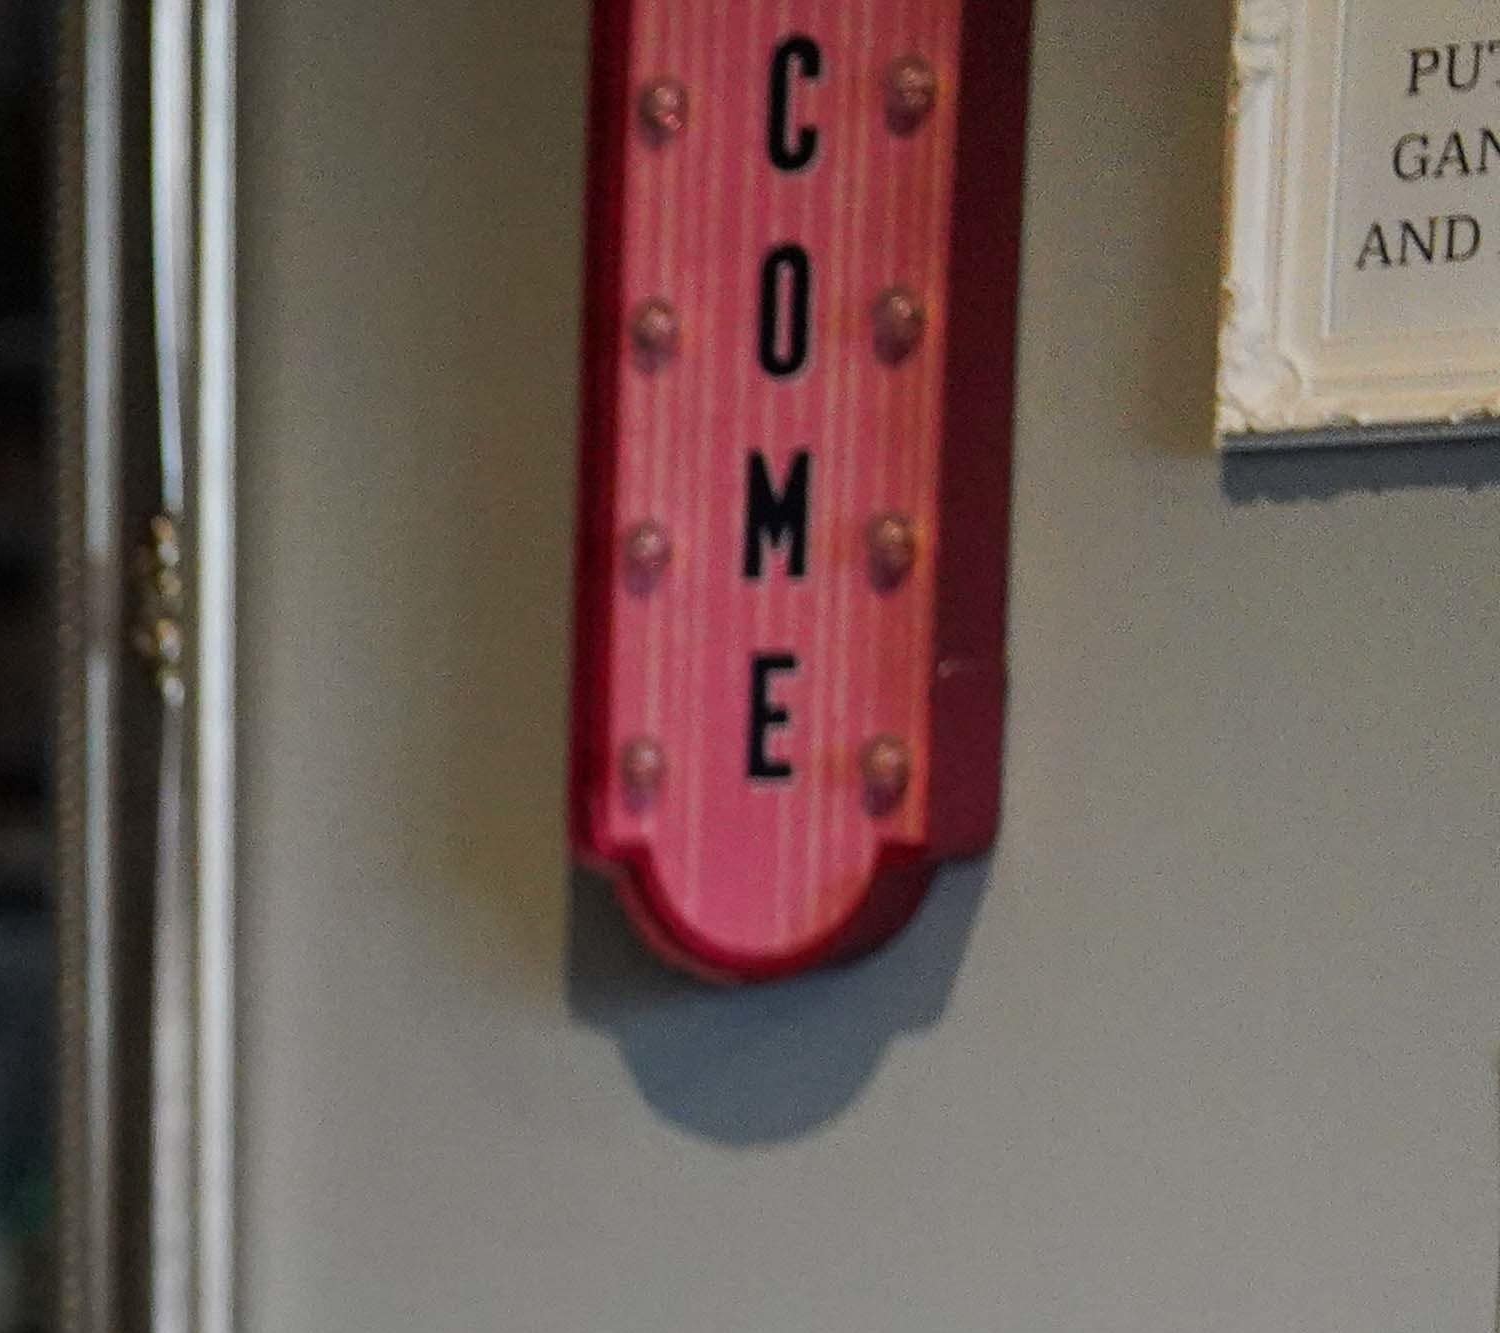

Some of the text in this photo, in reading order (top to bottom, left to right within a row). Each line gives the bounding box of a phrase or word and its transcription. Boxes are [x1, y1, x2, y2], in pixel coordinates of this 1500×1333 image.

[1407, 40, 1500, 96] PU
[1355, 213, 1482, 270] AND
[742, 35, 822, 780] COME
